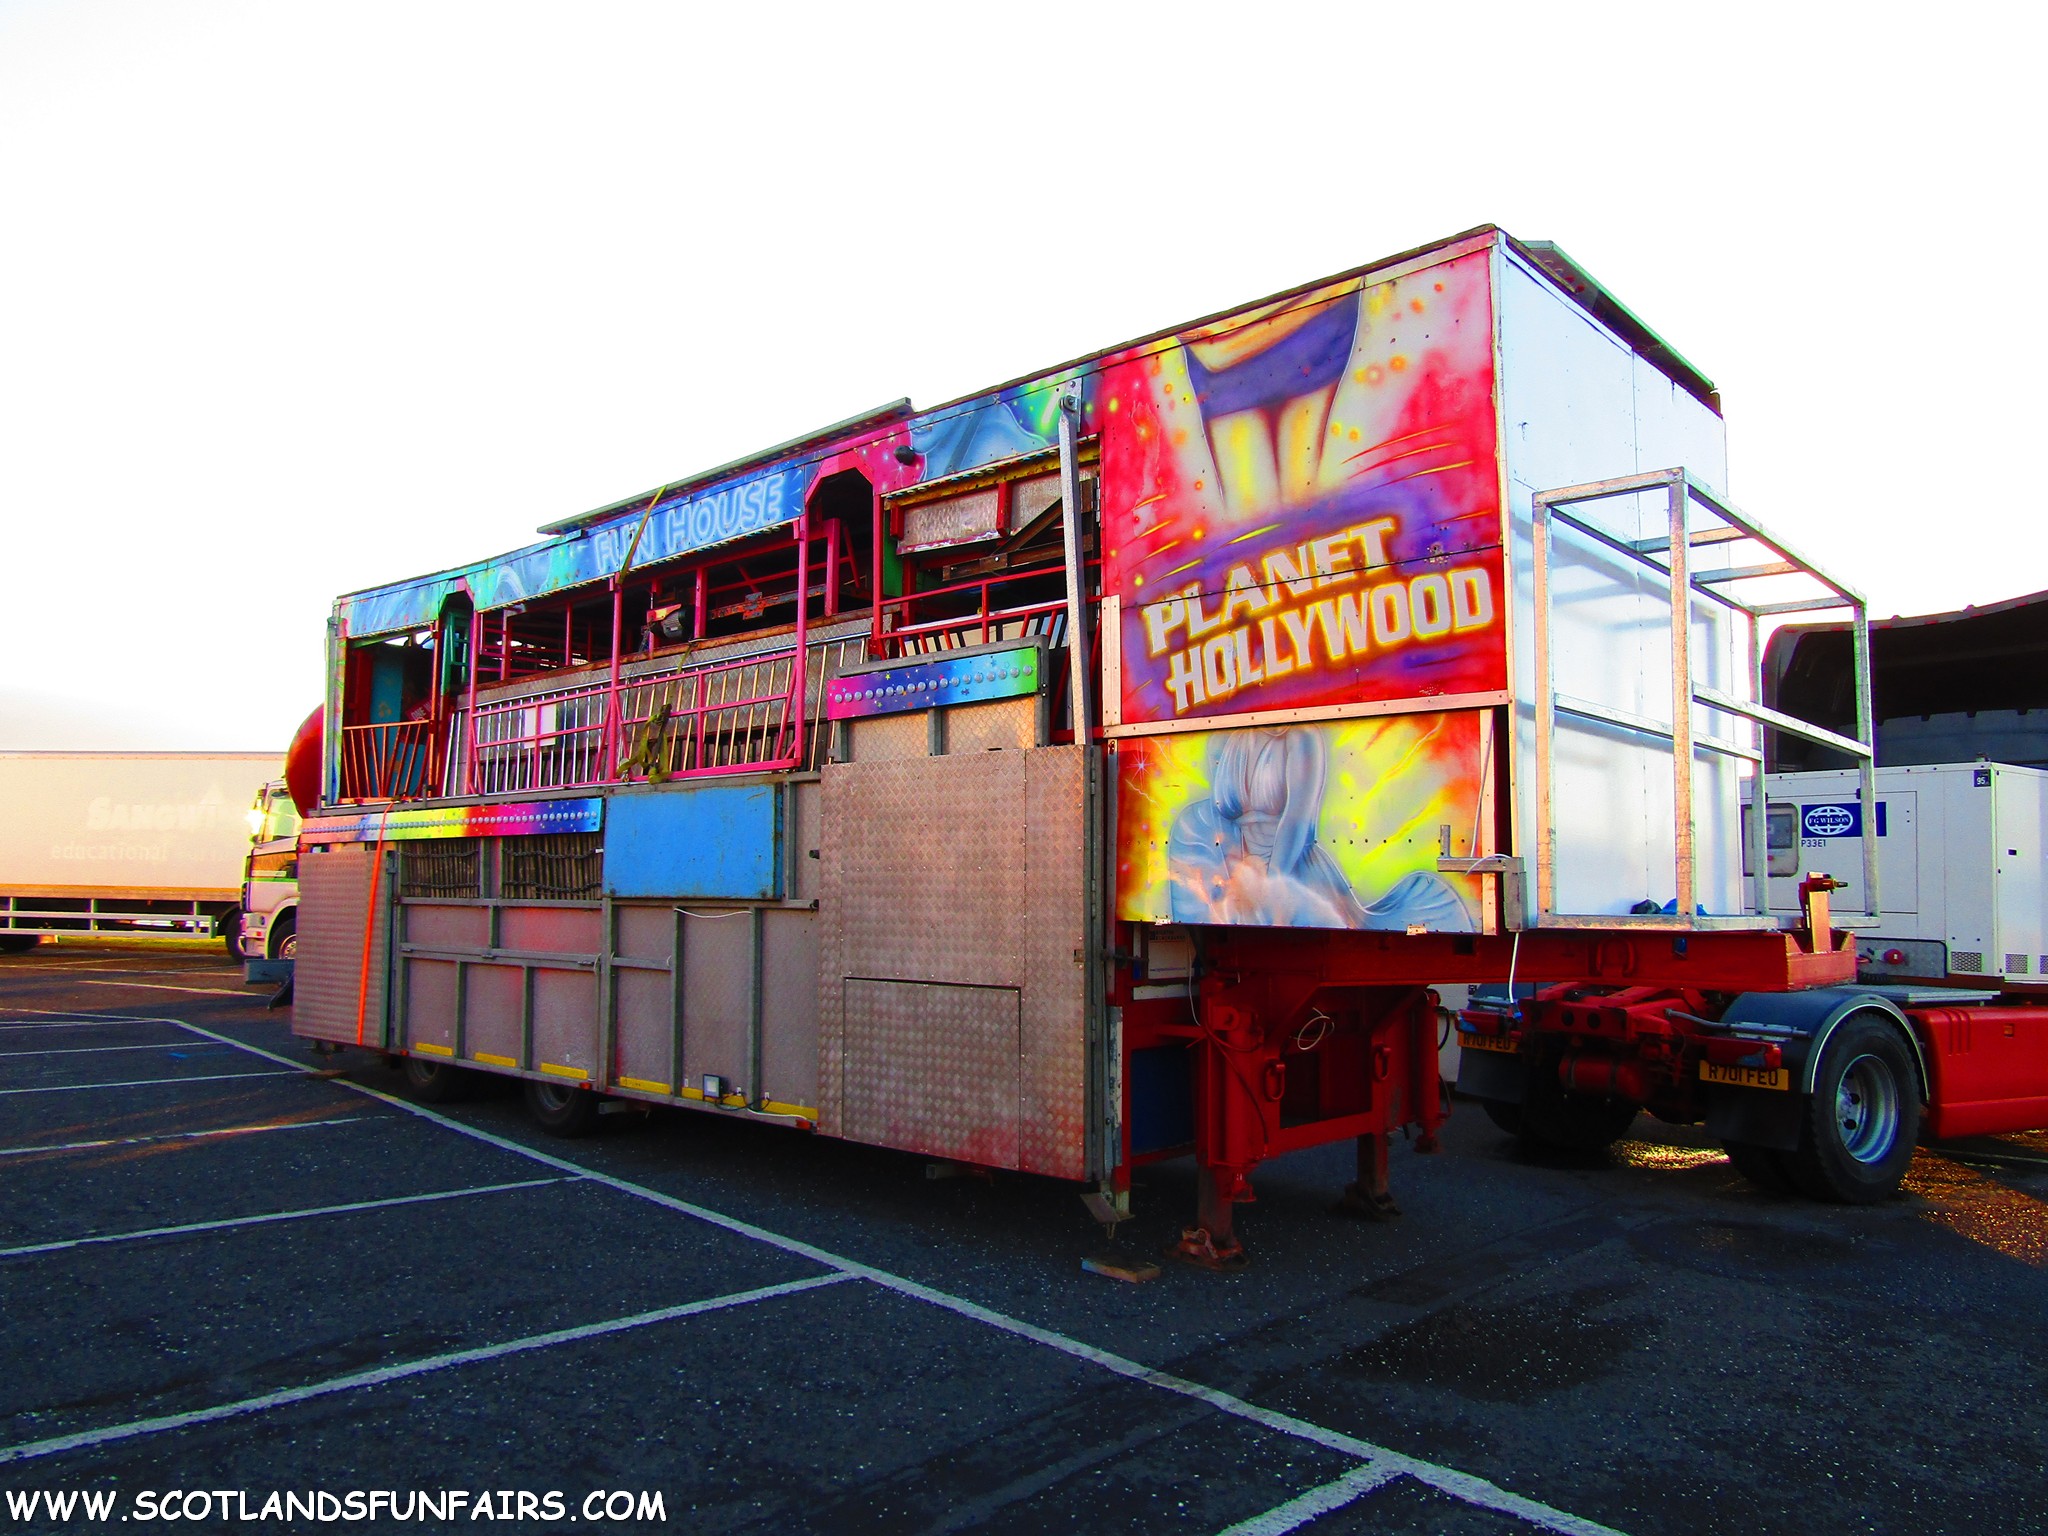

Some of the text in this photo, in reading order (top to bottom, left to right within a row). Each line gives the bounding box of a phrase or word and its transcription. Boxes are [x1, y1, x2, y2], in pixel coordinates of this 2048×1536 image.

[593, 473, 785, 573] FUN HOUSE
[1143, 519, 1395, 654] PLANET
[1168, 567, 1494, 711] HOLLYWOOD
[1800, 839, 1827, 848] P33E1
[1820, 816, 1850, 824] WILSON
